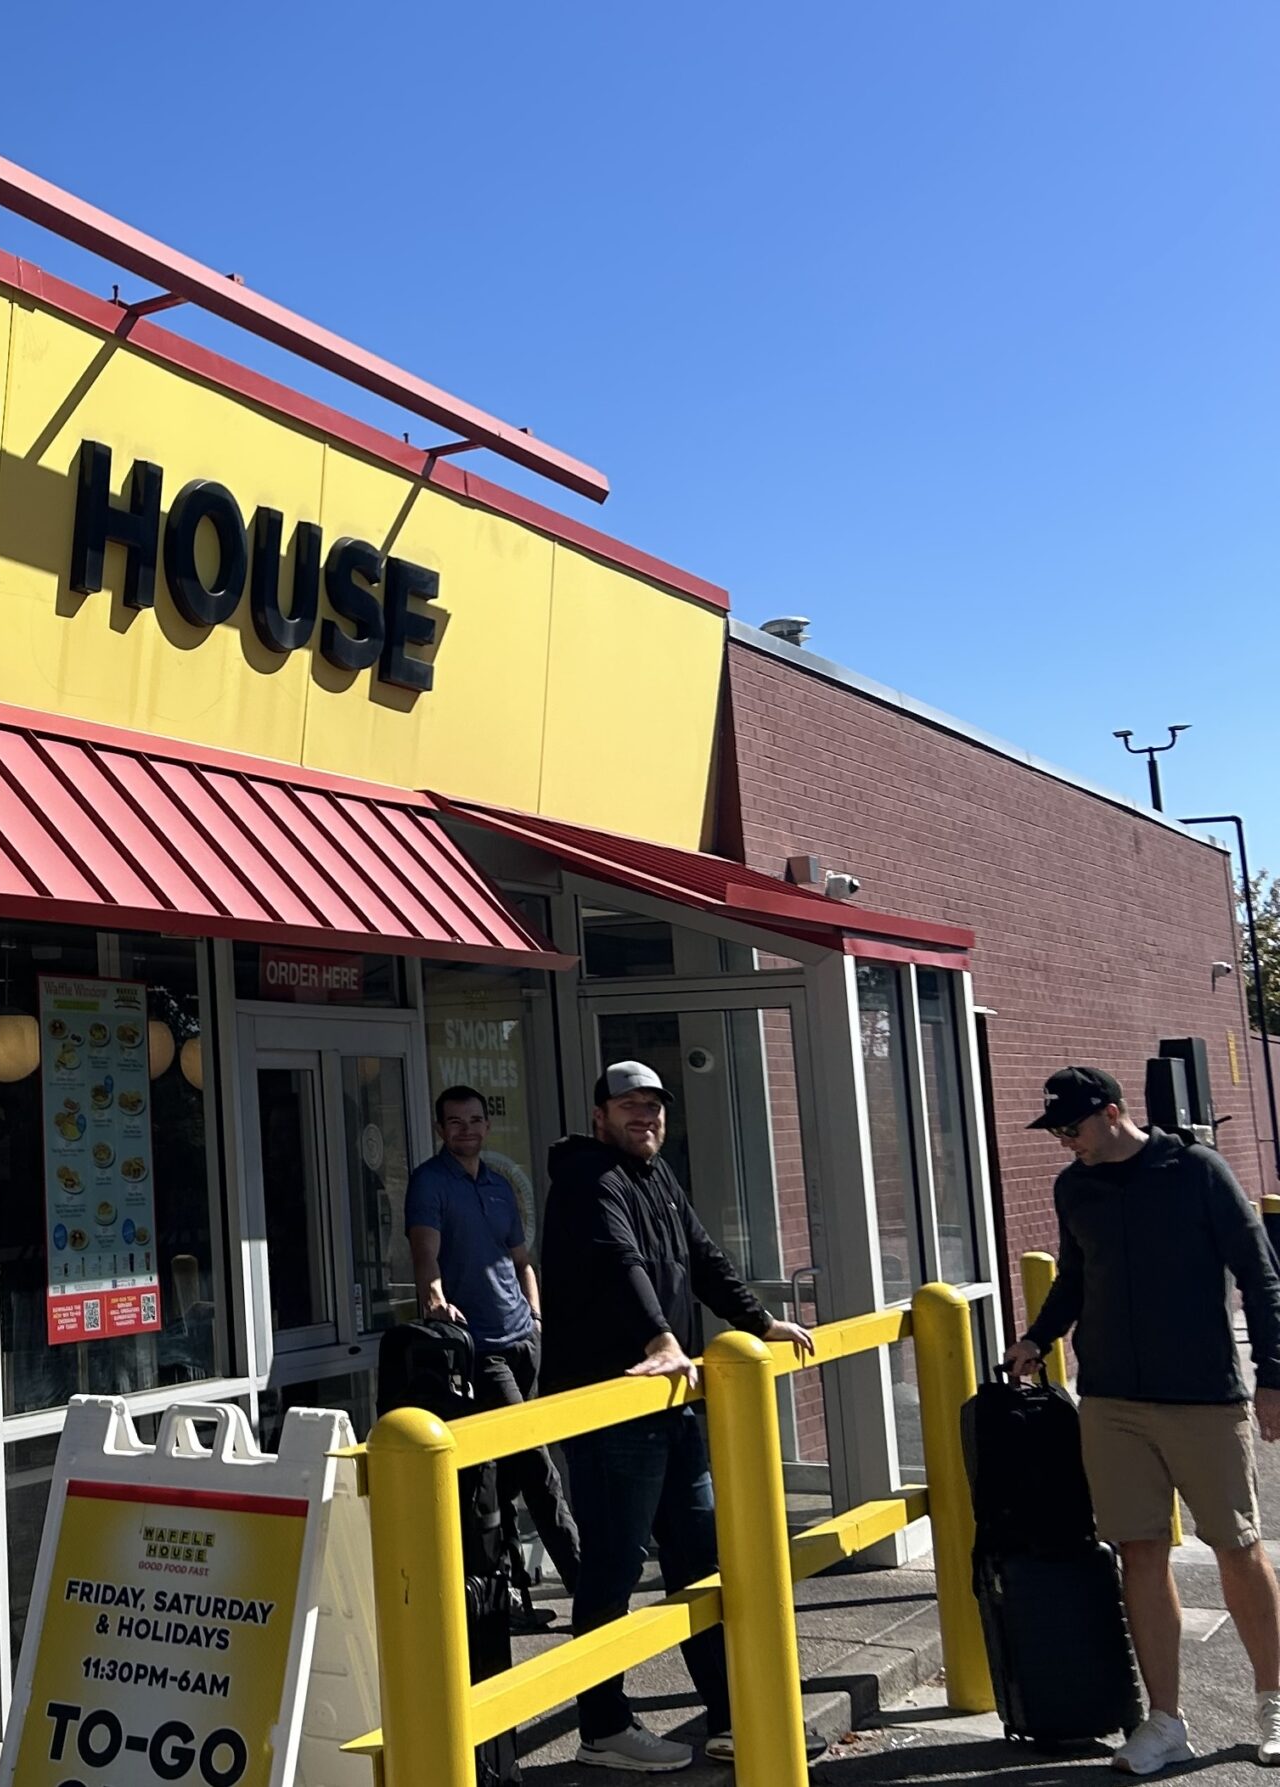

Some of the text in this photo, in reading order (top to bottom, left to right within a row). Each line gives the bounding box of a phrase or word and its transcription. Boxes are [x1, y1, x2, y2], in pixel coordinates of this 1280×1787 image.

[68, 438, 442, 693] HOUSE
[266, 960, 359, 990] ORDER HERE
[439, 1055, 519, 1088] WAFFLES
[142, 1526, 216, 1548] WAFFLE
[146, 1542, 208, 1564] HOUSE
[138, 1560, 210, 1577] GOOD FOOD FAST
[65, 1579, 275, 1626] FRIDAY, SATURDAY
[95, 1614, 231, 1651] & HOLIDAYS
[81, 1656, 231, 1698] 11:30PM-6AM
[46, 1702, 248, 1787] TO-GO
